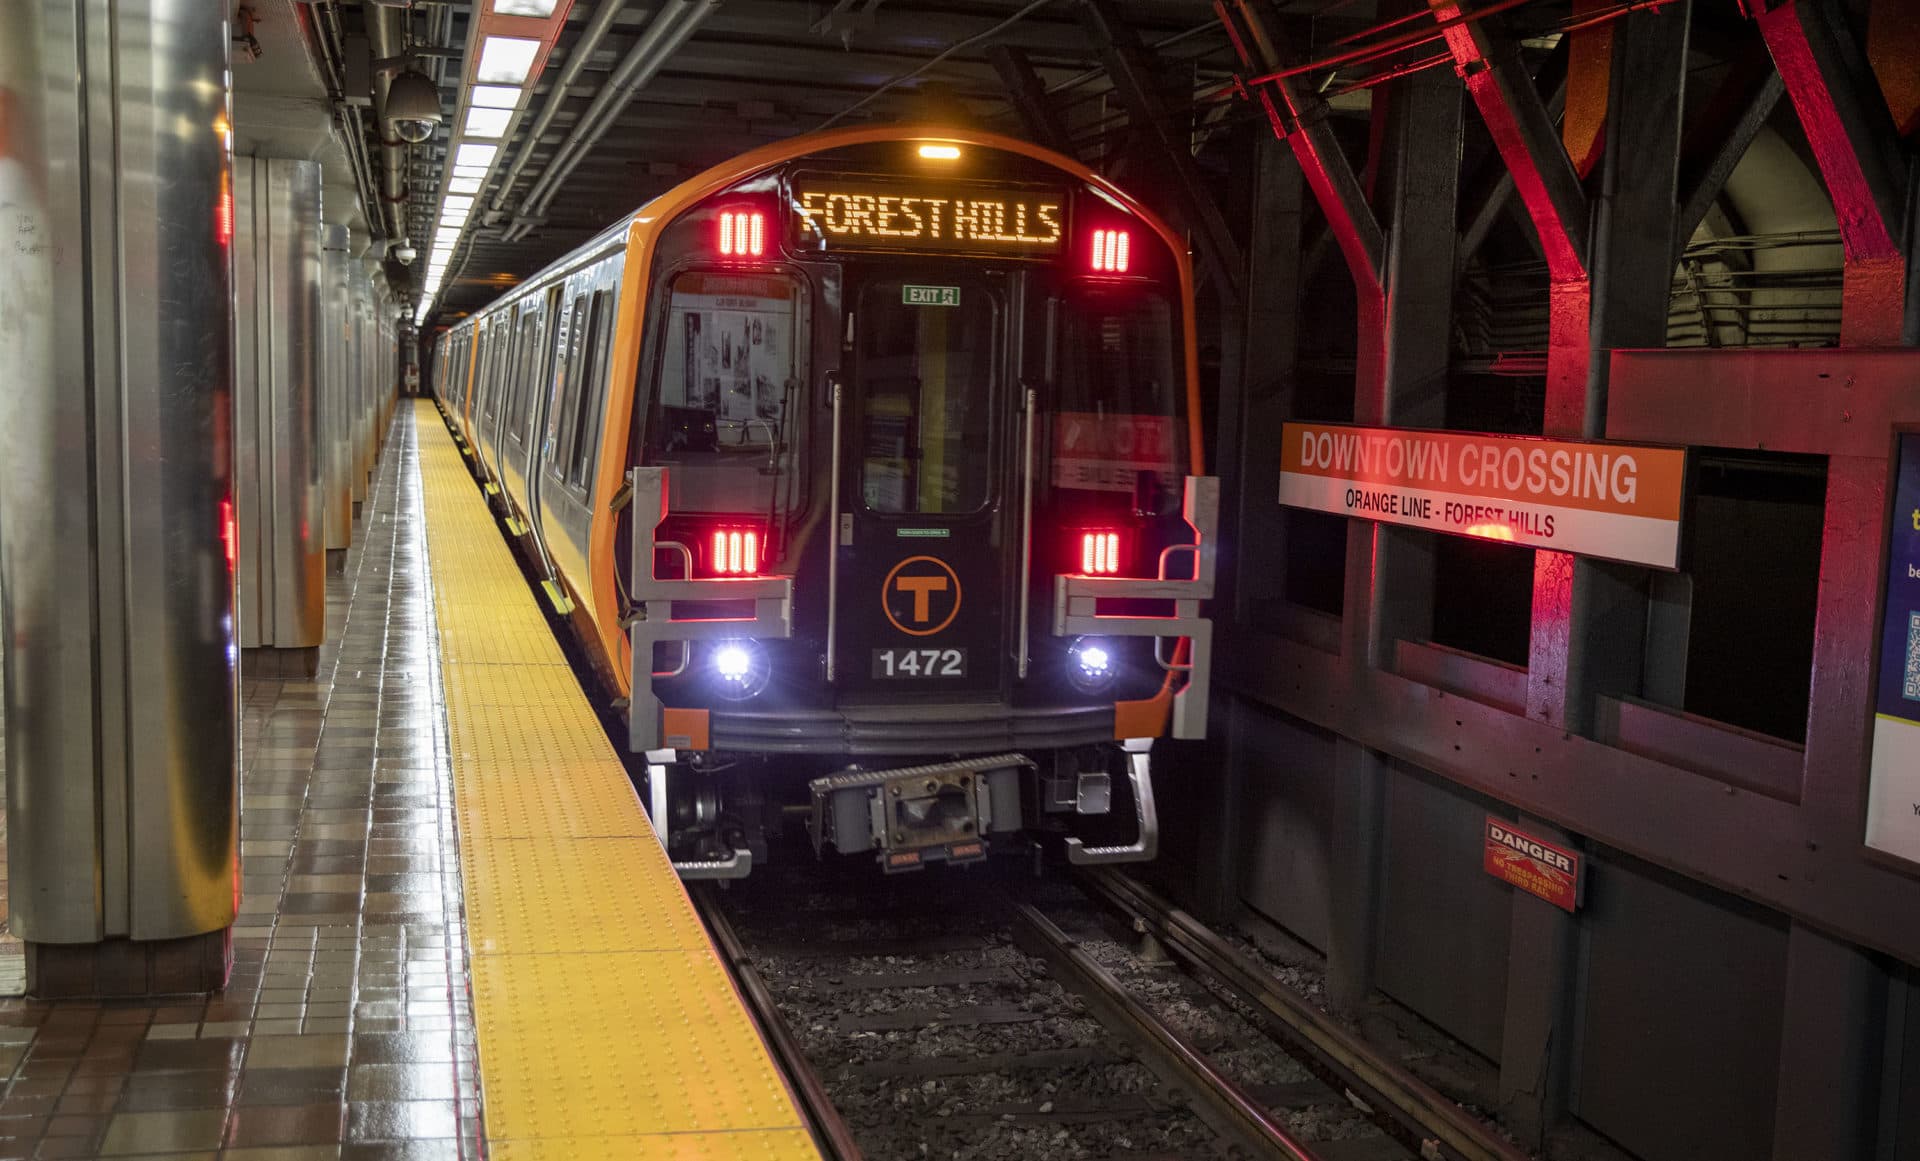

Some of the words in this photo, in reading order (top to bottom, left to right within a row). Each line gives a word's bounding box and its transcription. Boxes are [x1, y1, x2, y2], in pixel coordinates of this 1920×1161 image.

[803, 192, 948, 238] FOREST
[955, 200, 1061, 243] HILLS
[910, 288, 940, 303] EXIT
[1301, 431, 1449, 483] DOWNTOWN
[1458, 443, 1637, 504] CROSSING
[1346, 488, 1398, 514] ORANGE
[1401, 495, 1431, 520] LINE
[1508, 508, 1555, 538] HILLS
[896, 576, 947, 622] T
[880, 650, 962, 676] 1472
[1491, 827, 1569, 871] DANGER
